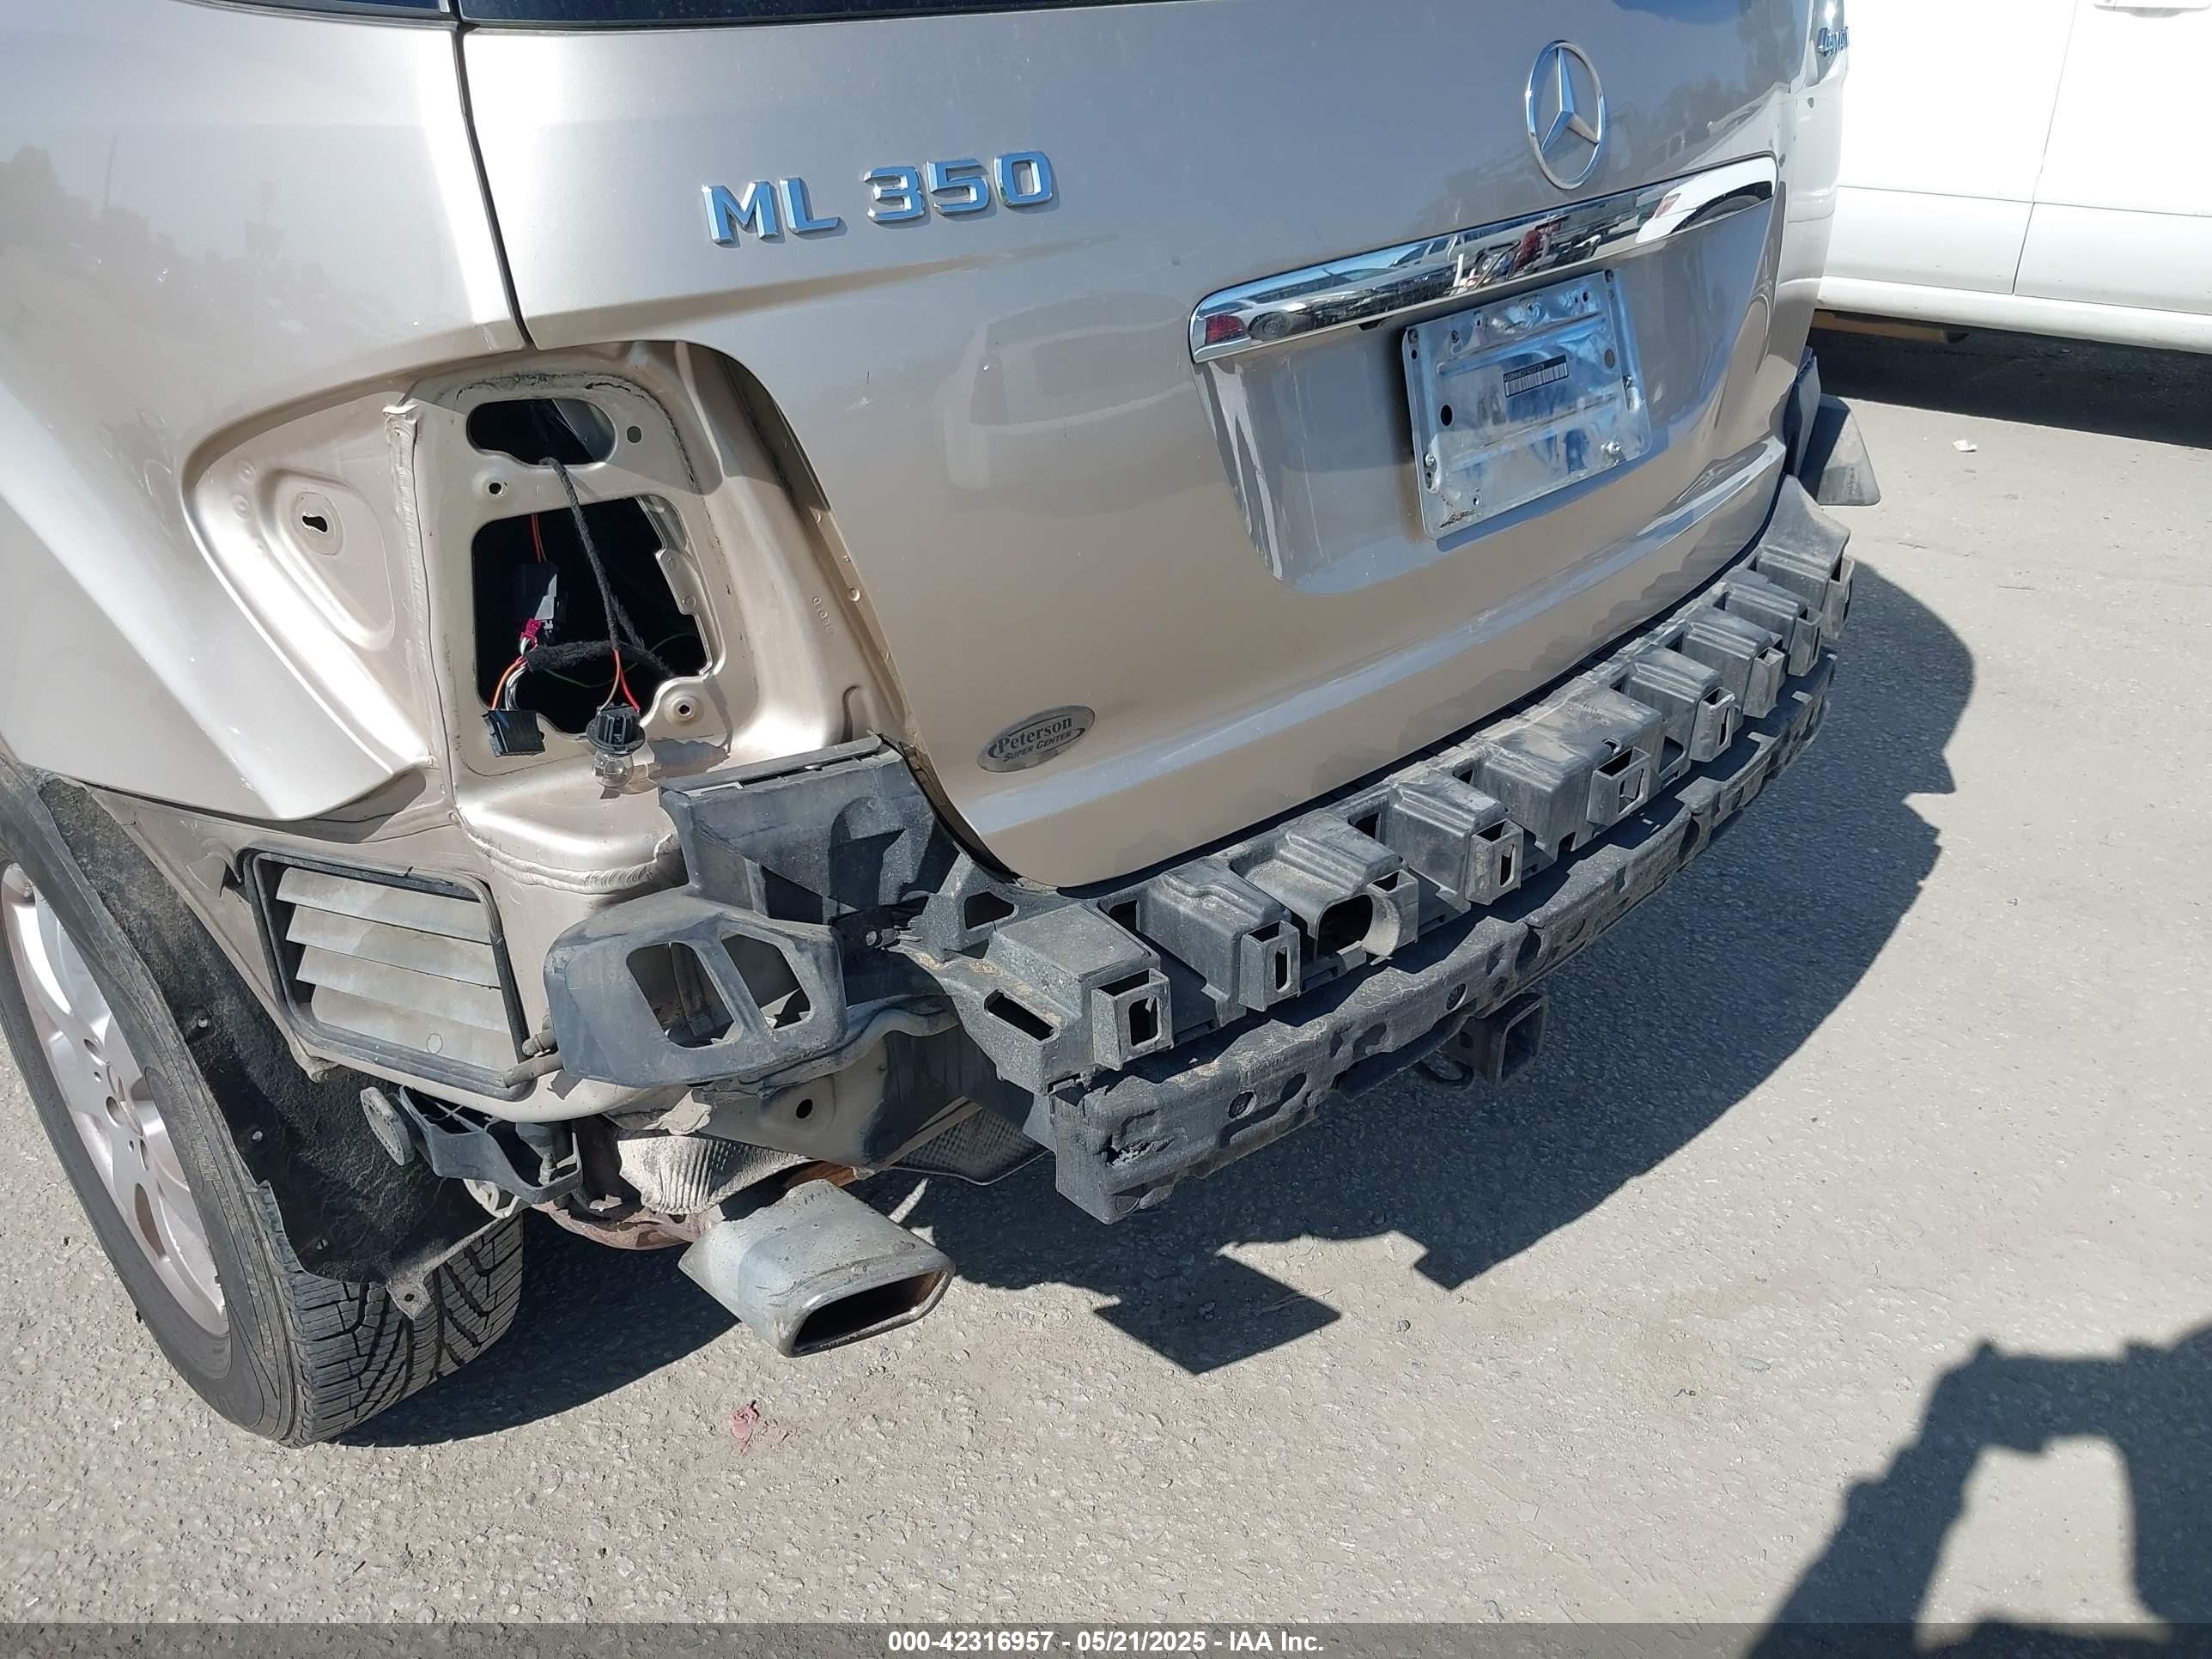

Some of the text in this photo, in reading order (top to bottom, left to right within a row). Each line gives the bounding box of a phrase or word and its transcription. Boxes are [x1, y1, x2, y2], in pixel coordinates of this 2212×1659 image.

[702, 151, 1053, 244] ML 350
[996, 717, 1073, 754] Peterson
[1002, 730, 1073, 763] SUPER CENTER
